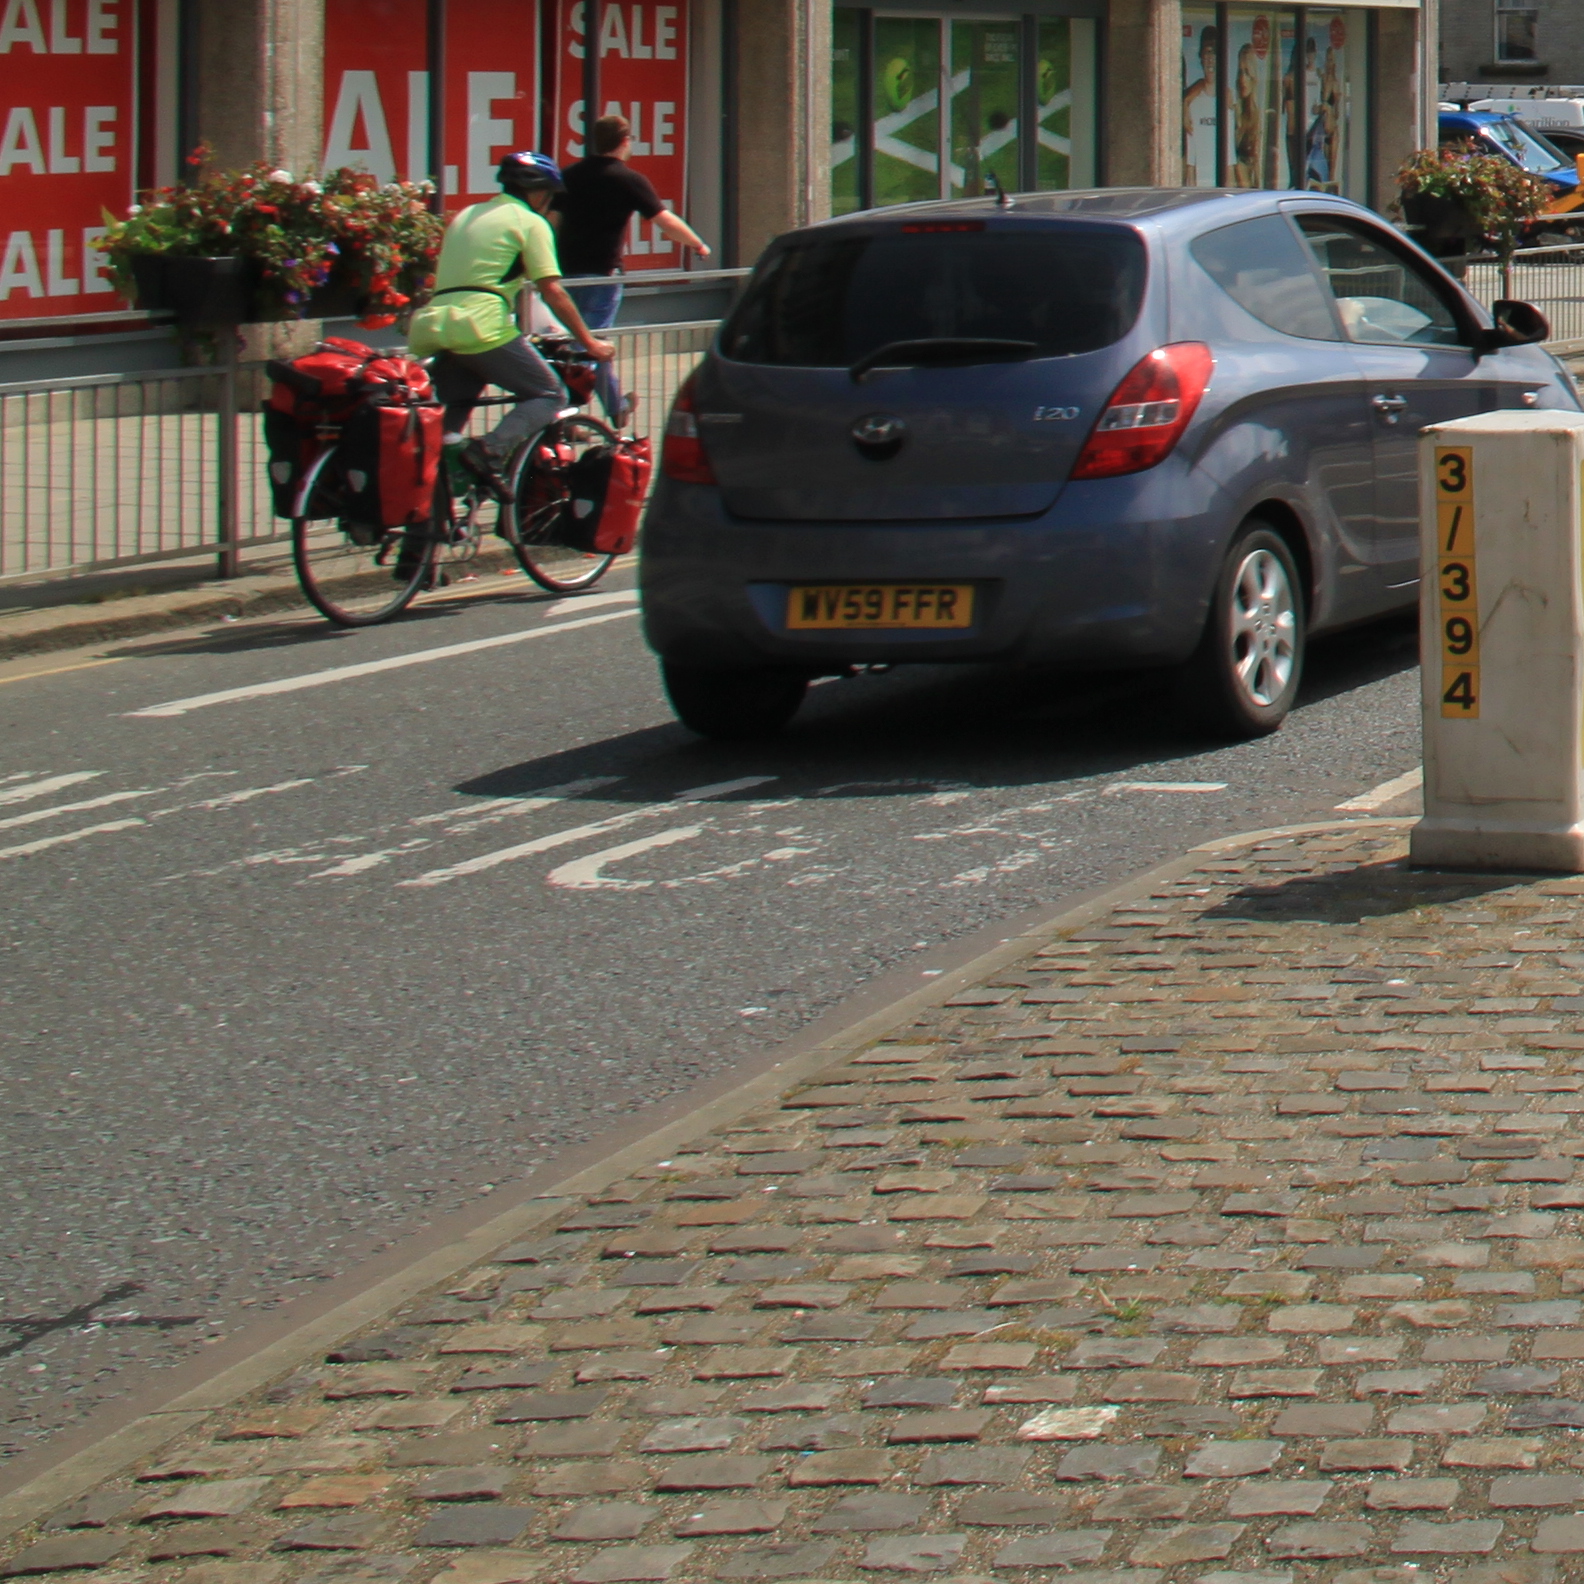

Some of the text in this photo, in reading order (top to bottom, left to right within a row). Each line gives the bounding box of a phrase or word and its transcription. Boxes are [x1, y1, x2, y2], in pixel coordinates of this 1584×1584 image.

[567, 1, 677, 59] SALE
[0, 106, 117, 175] ALE
[322, 70, 516, 194] ALE
[0, 227, 114, 300] ALE
[1033, 406, 1080, 421] i20
